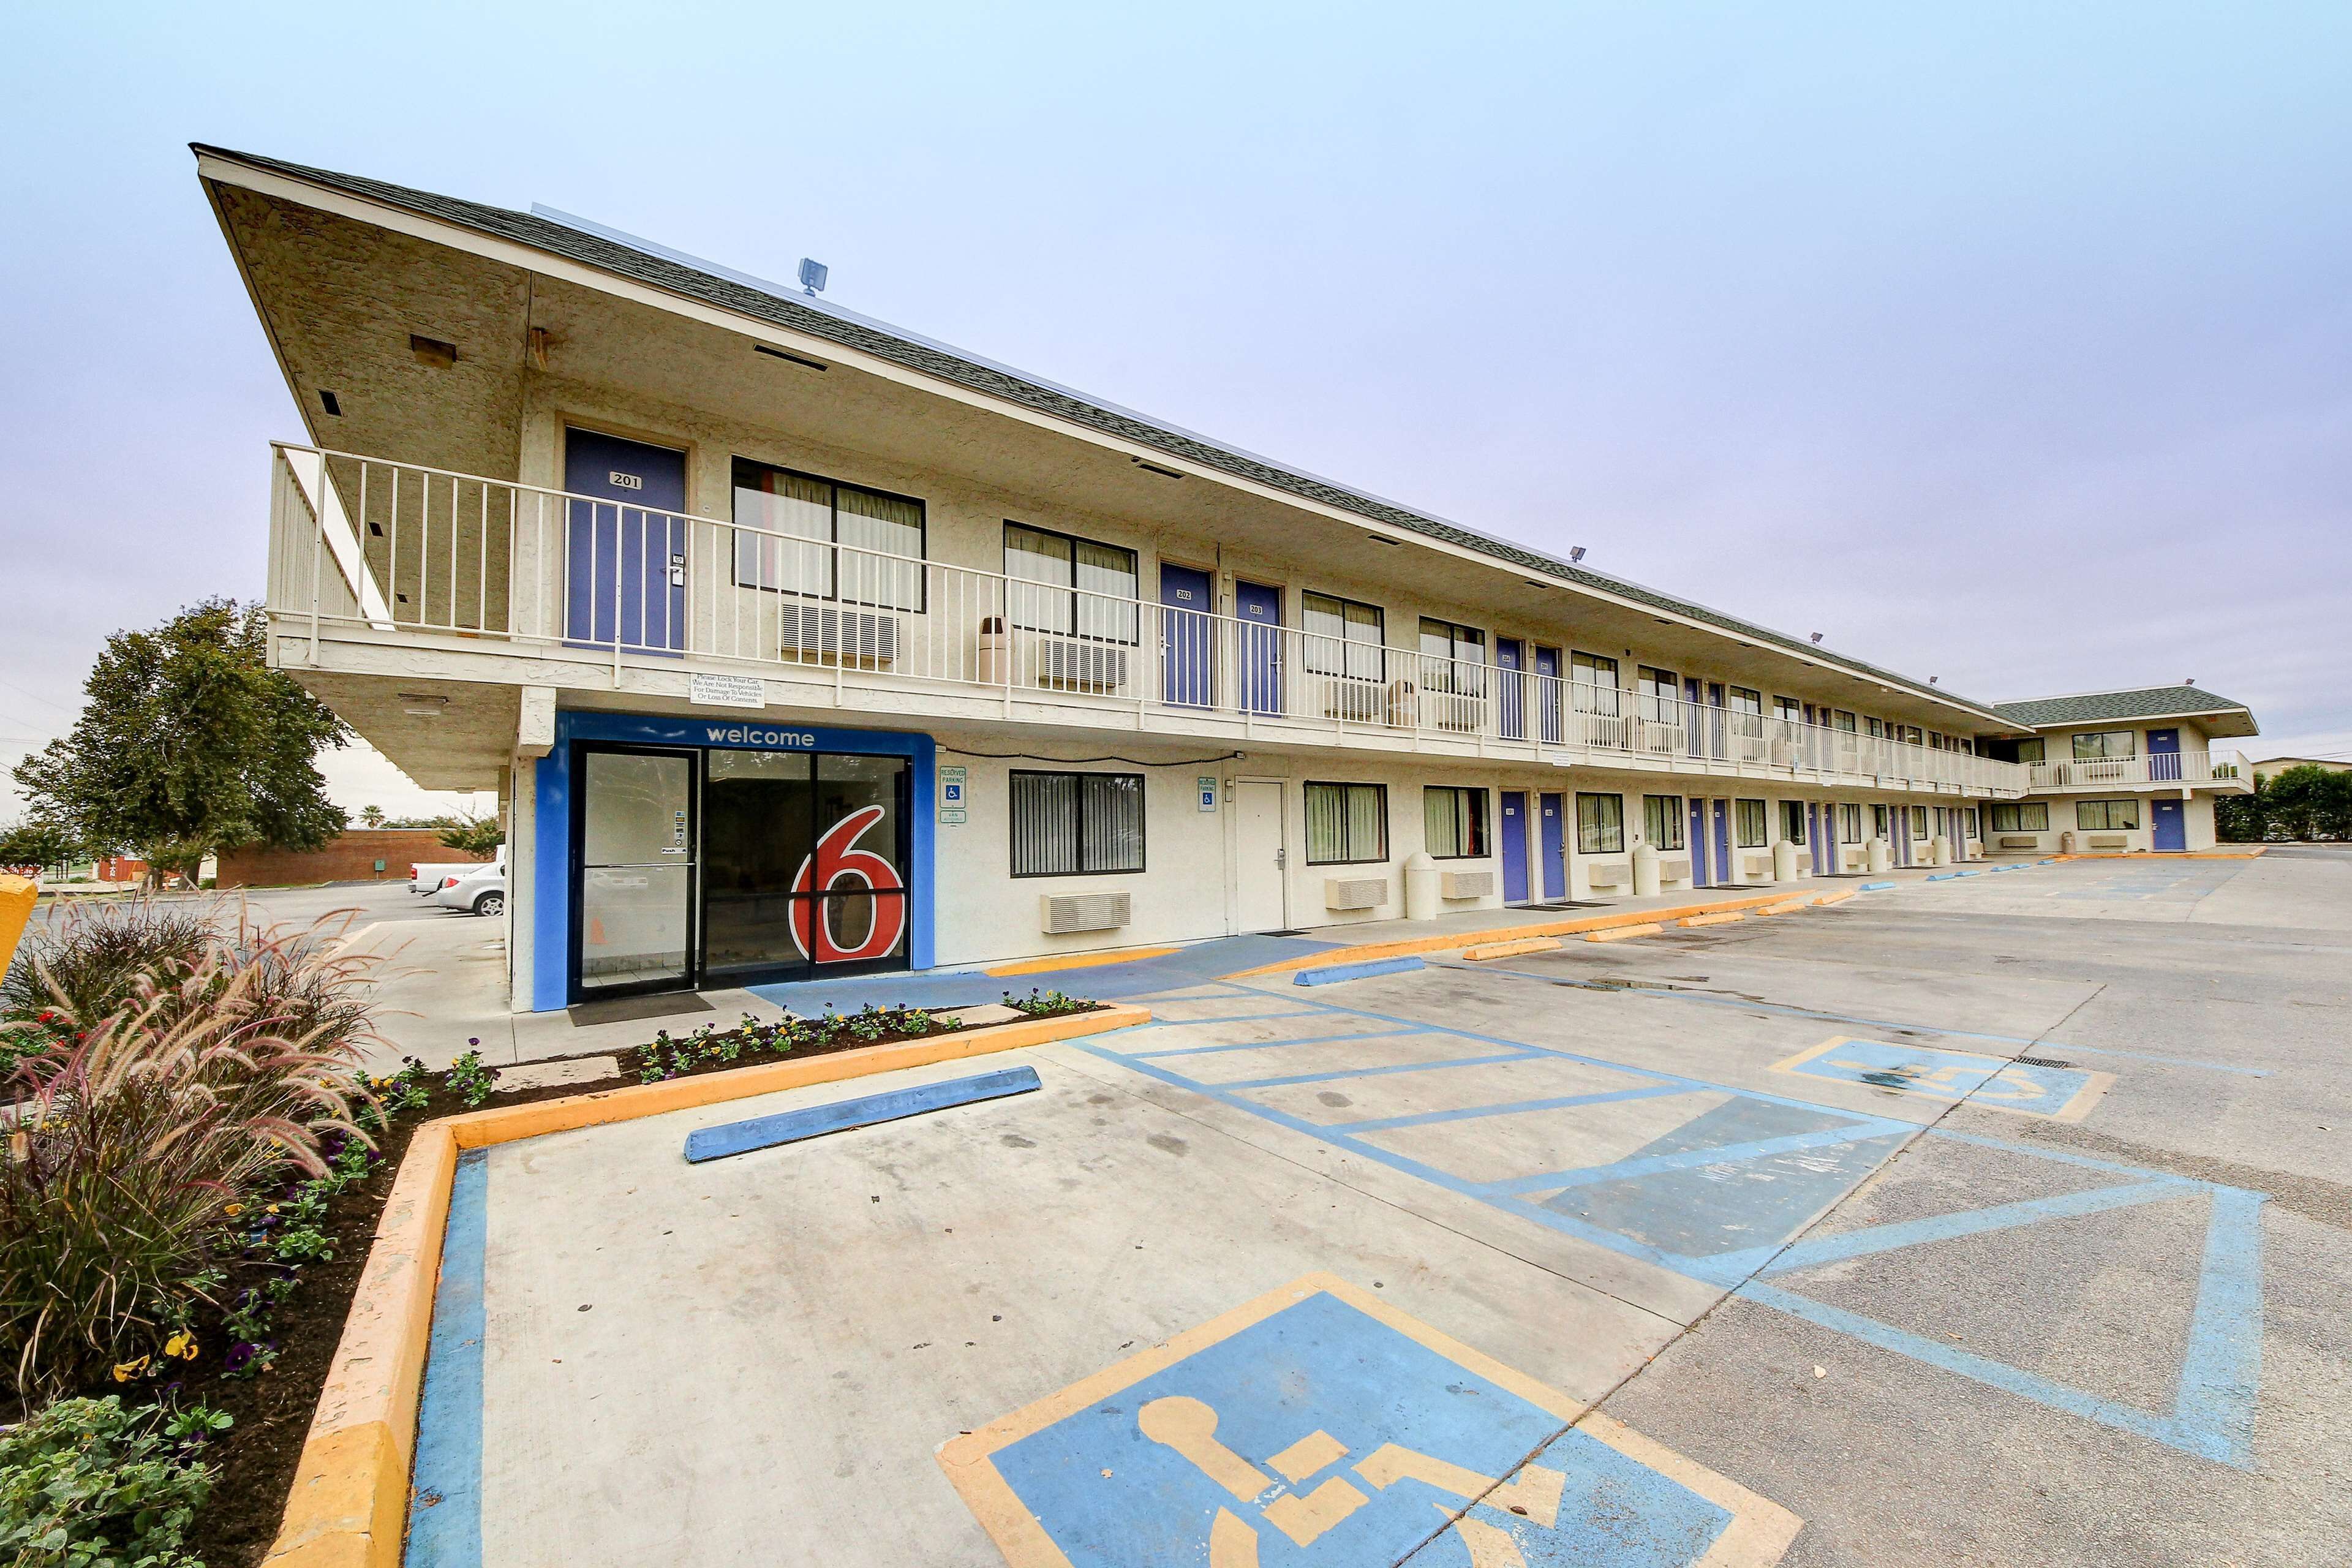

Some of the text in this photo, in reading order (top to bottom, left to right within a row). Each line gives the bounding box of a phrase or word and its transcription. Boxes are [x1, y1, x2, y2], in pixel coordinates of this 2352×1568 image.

[614, 474, 638, 488] 201
[1178, 590, 1190, 599] 202
[706, 687, 730, 696] Damage
[706, 726, 815, 747] welcome
[788, 804, 905, 964] 6
